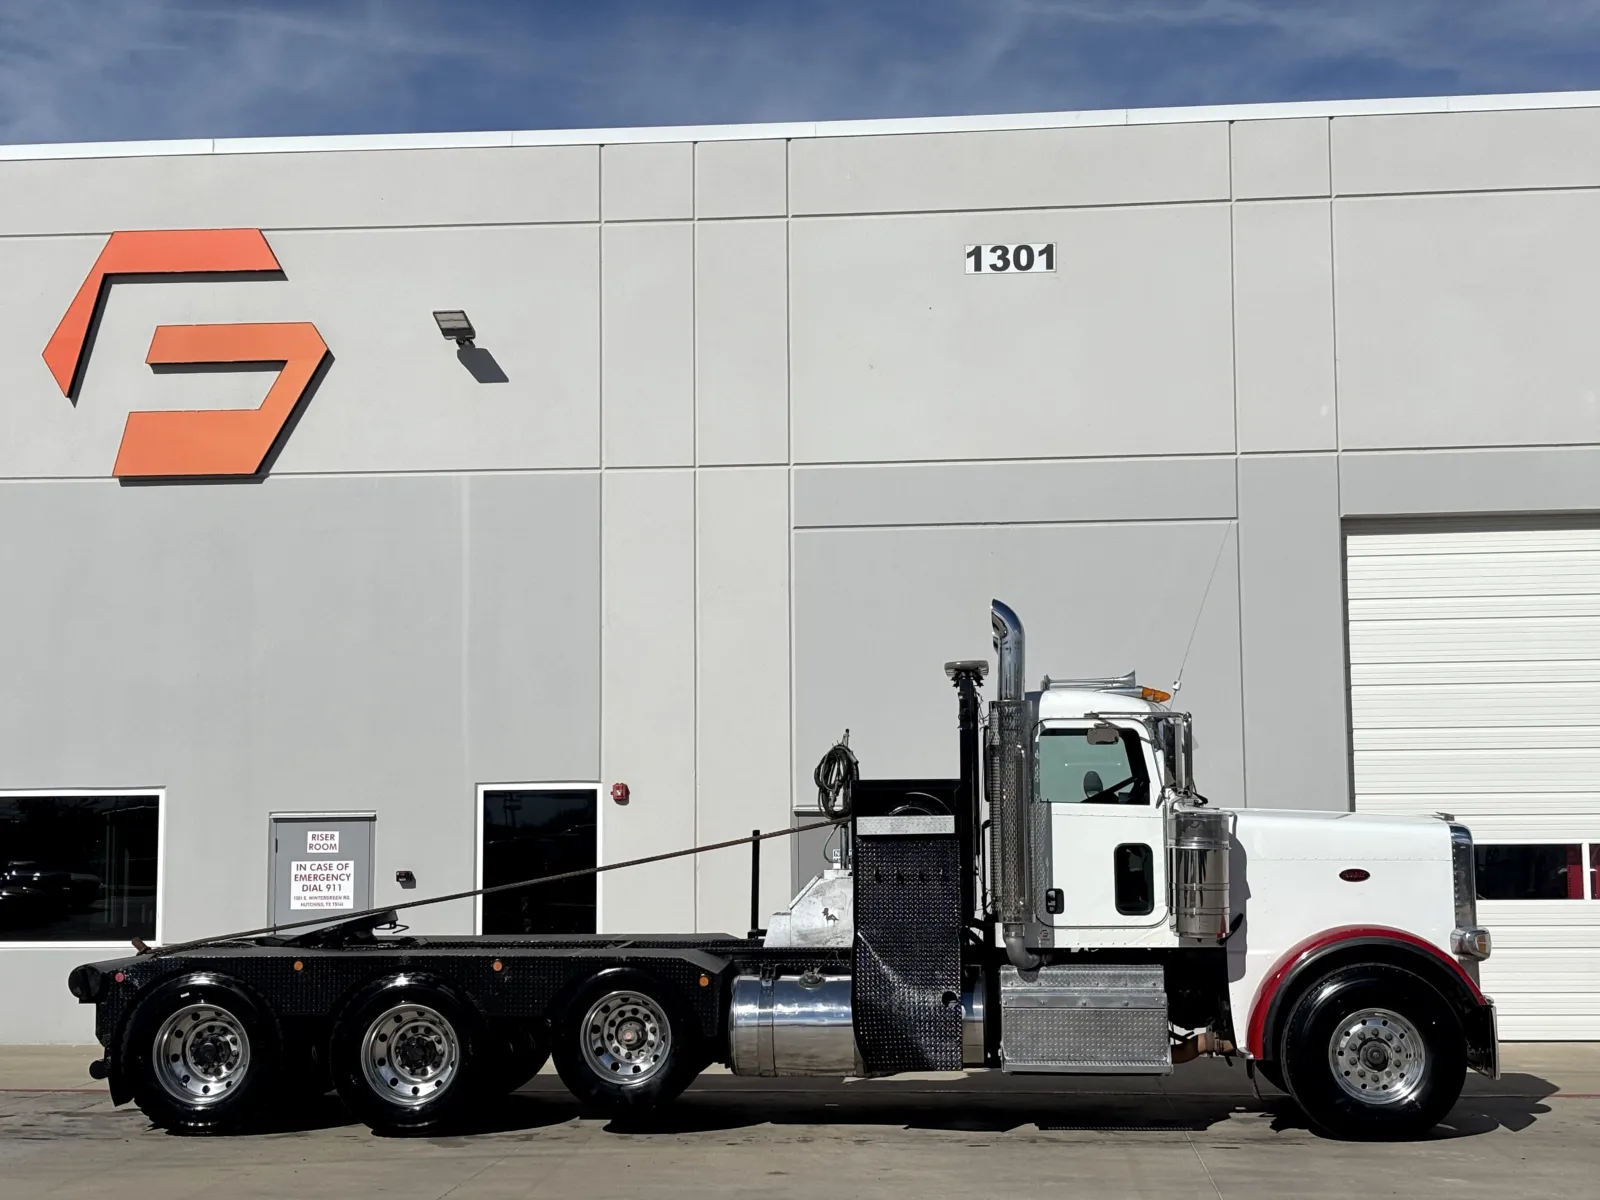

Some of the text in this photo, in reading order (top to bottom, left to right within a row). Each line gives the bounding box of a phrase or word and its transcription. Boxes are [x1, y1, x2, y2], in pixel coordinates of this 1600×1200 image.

[966, 243, 1054, 272] 1301
[311, 833, 335, 841] RISER
[308, 843, 337, 851] ROOM
[296, 863, 349, 871] IN CASE OF
[294, 873, 351, 882] EMERGENCY
[302, 884, 342, 892] DIAL 911
